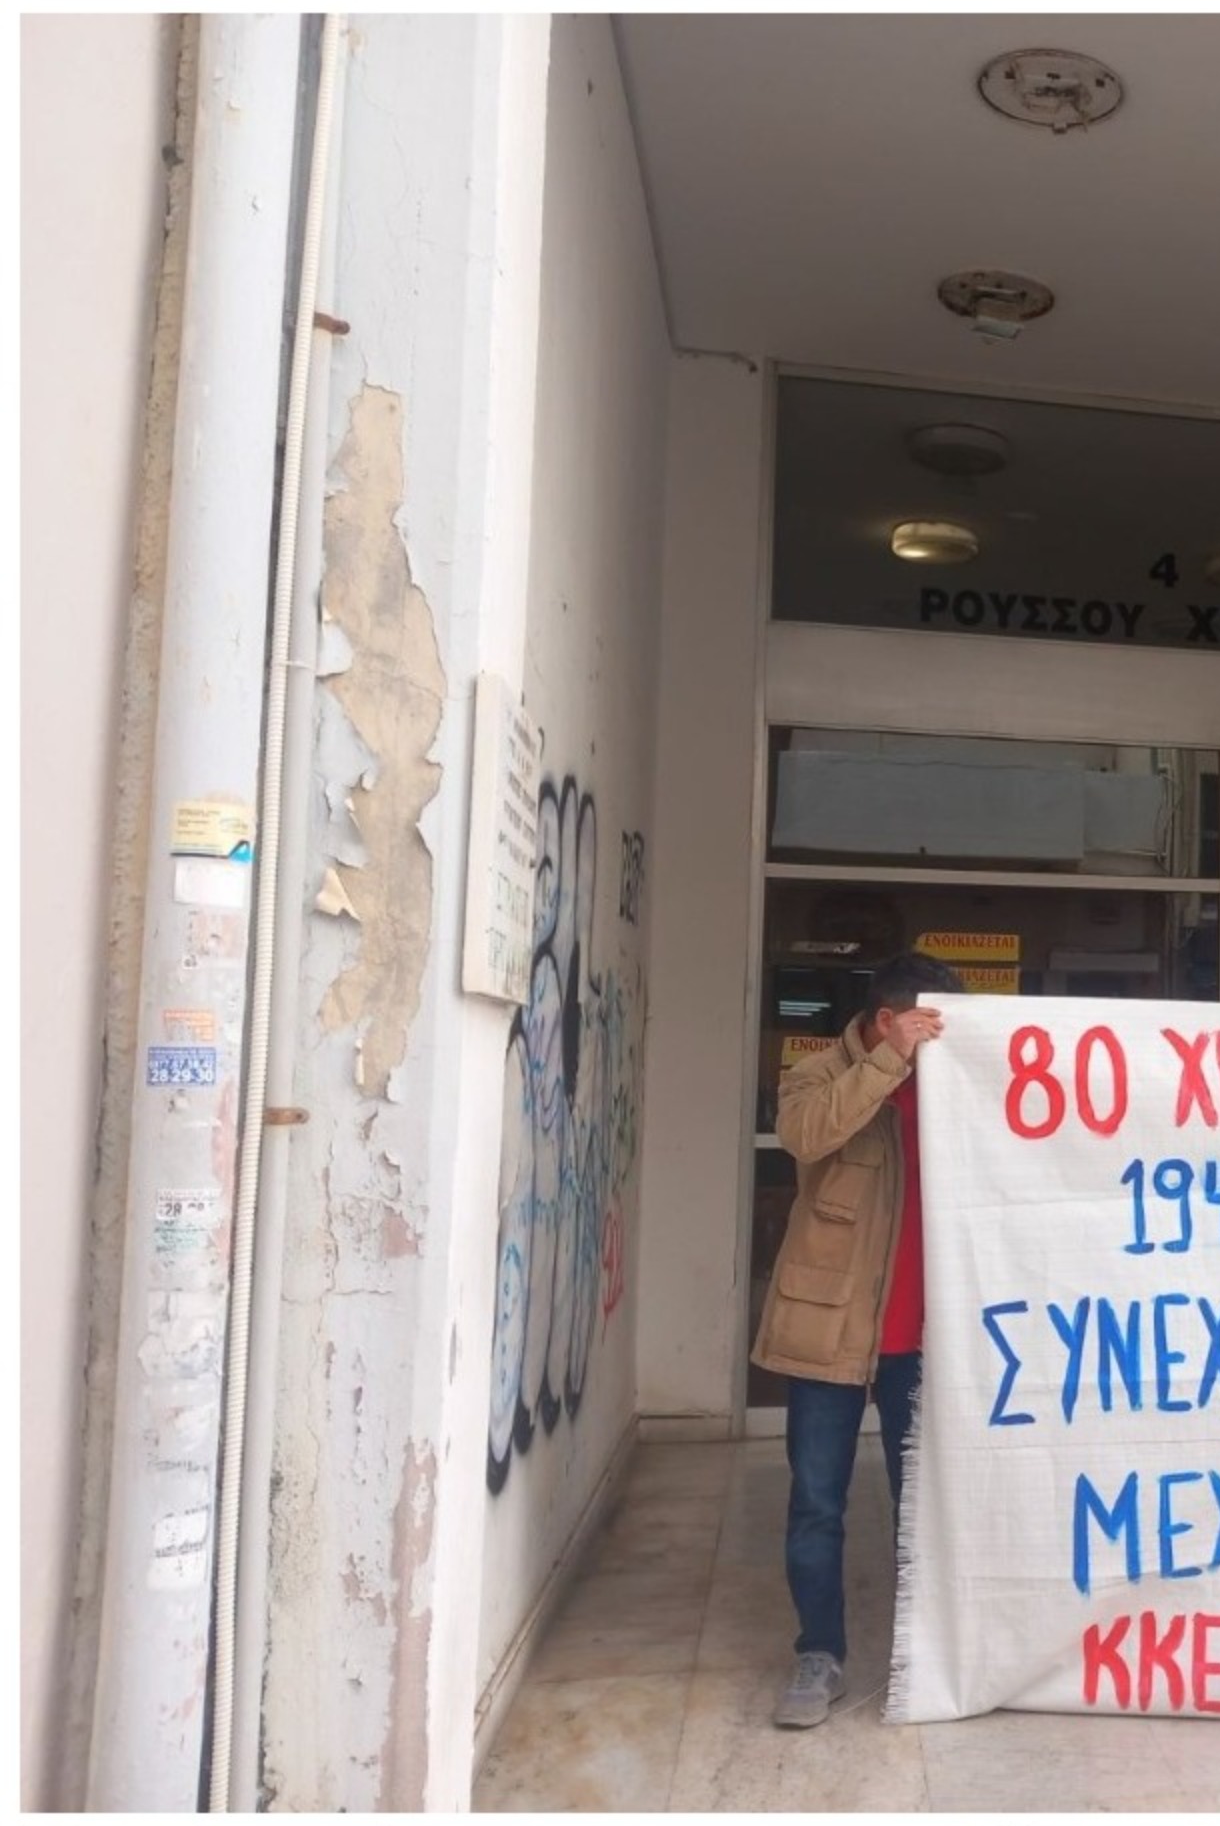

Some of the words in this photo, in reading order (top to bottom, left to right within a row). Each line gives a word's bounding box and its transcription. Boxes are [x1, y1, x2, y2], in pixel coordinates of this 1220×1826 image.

[1150, 554, 1179, 587] 4
[920, 588, 1145, 637] ΡΟΥΣΣΟΥ
[925, 934, 1016, 948] ΕΝΟΙΚΙΑΖΕΤΑΙ
[1005, 1025, 1128, 1139] 80
